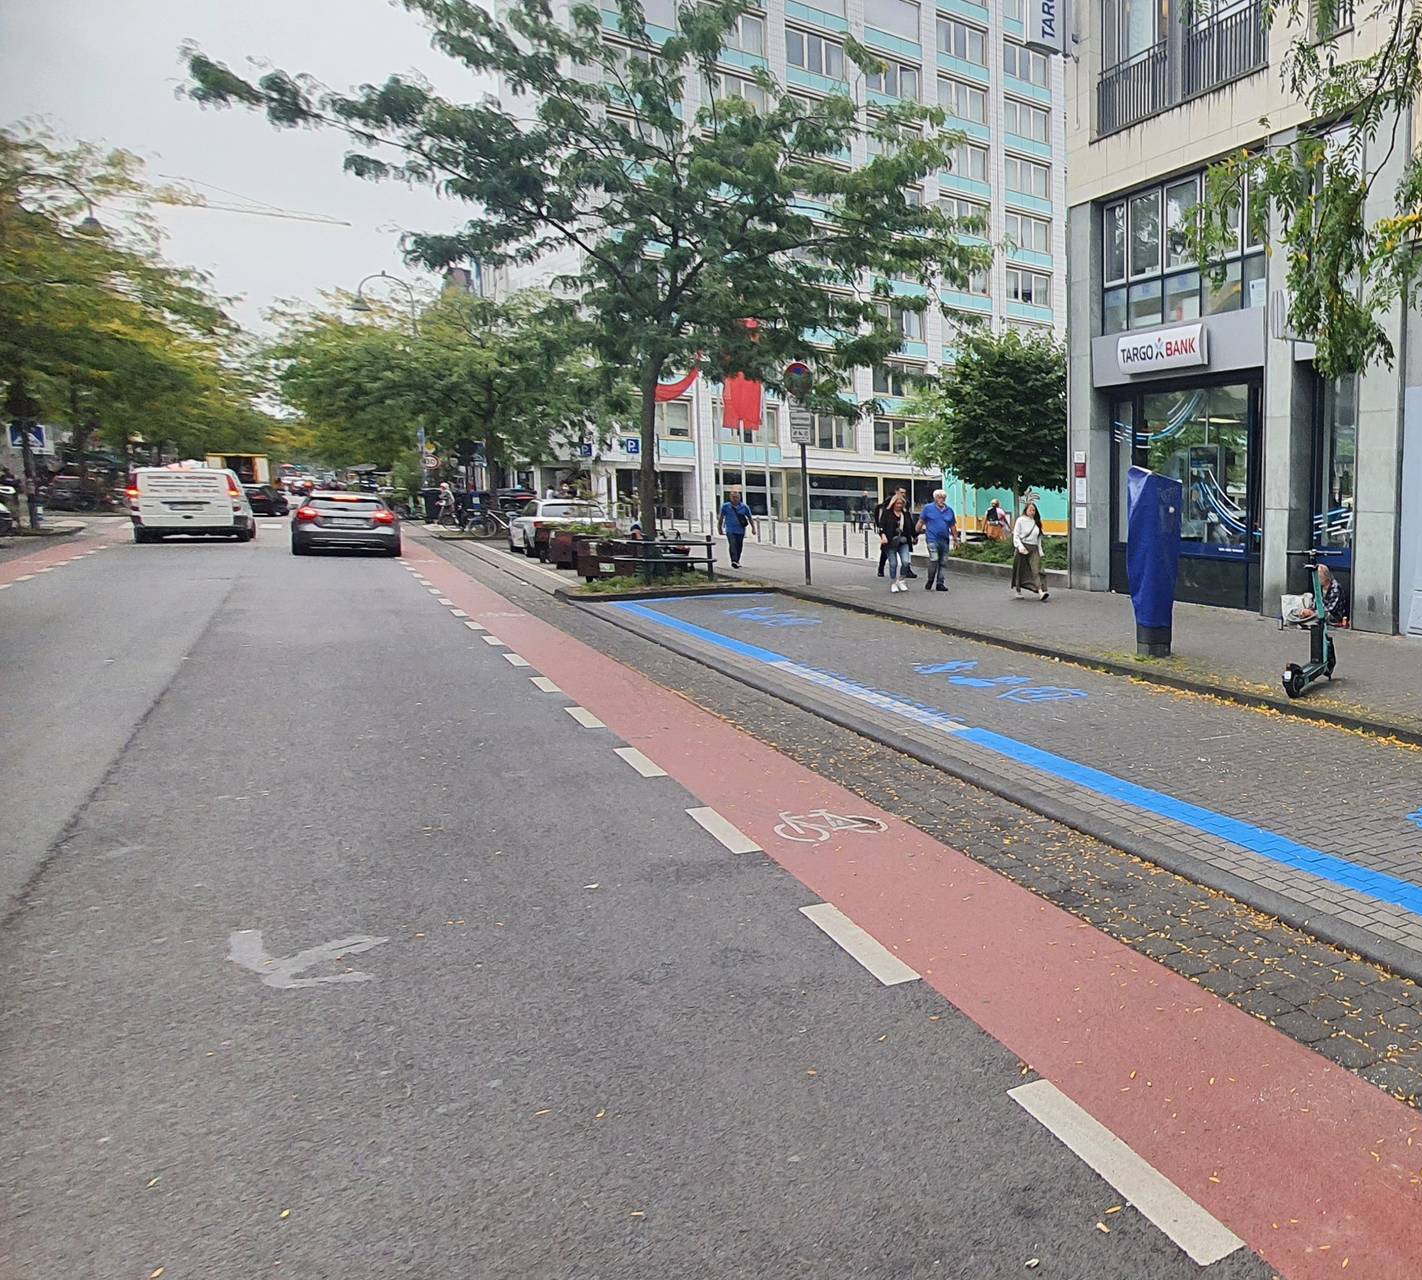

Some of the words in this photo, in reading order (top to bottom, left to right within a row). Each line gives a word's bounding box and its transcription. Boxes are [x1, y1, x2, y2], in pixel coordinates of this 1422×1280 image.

[1041, 0, 1055, 39] TAR
[1120, 344, 1154, 364] TARGO
[1165, 336, 1196, 357] BANK
